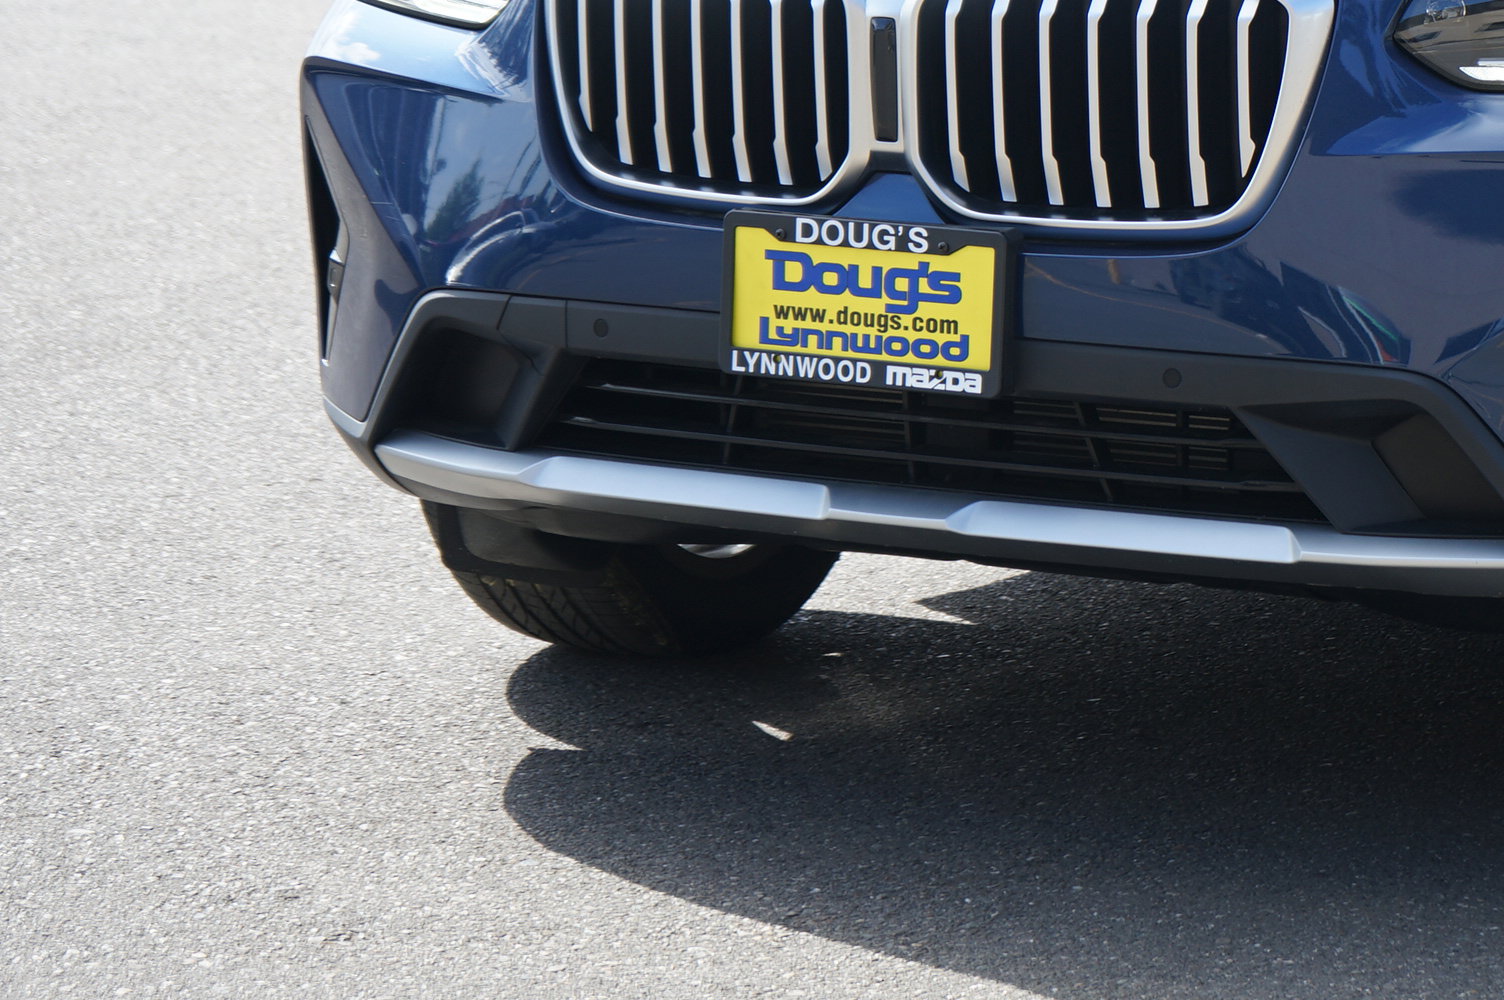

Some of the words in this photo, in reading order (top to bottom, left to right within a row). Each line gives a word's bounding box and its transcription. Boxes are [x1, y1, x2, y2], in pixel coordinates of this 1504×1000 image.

[794, 217, 929, 254] DOUG'S
[773, 304, 959, 335] www.dougs.com
[758, 316, 970, 363] Lynnwood
[731, 350, 872, 384] LYNNWOOD
